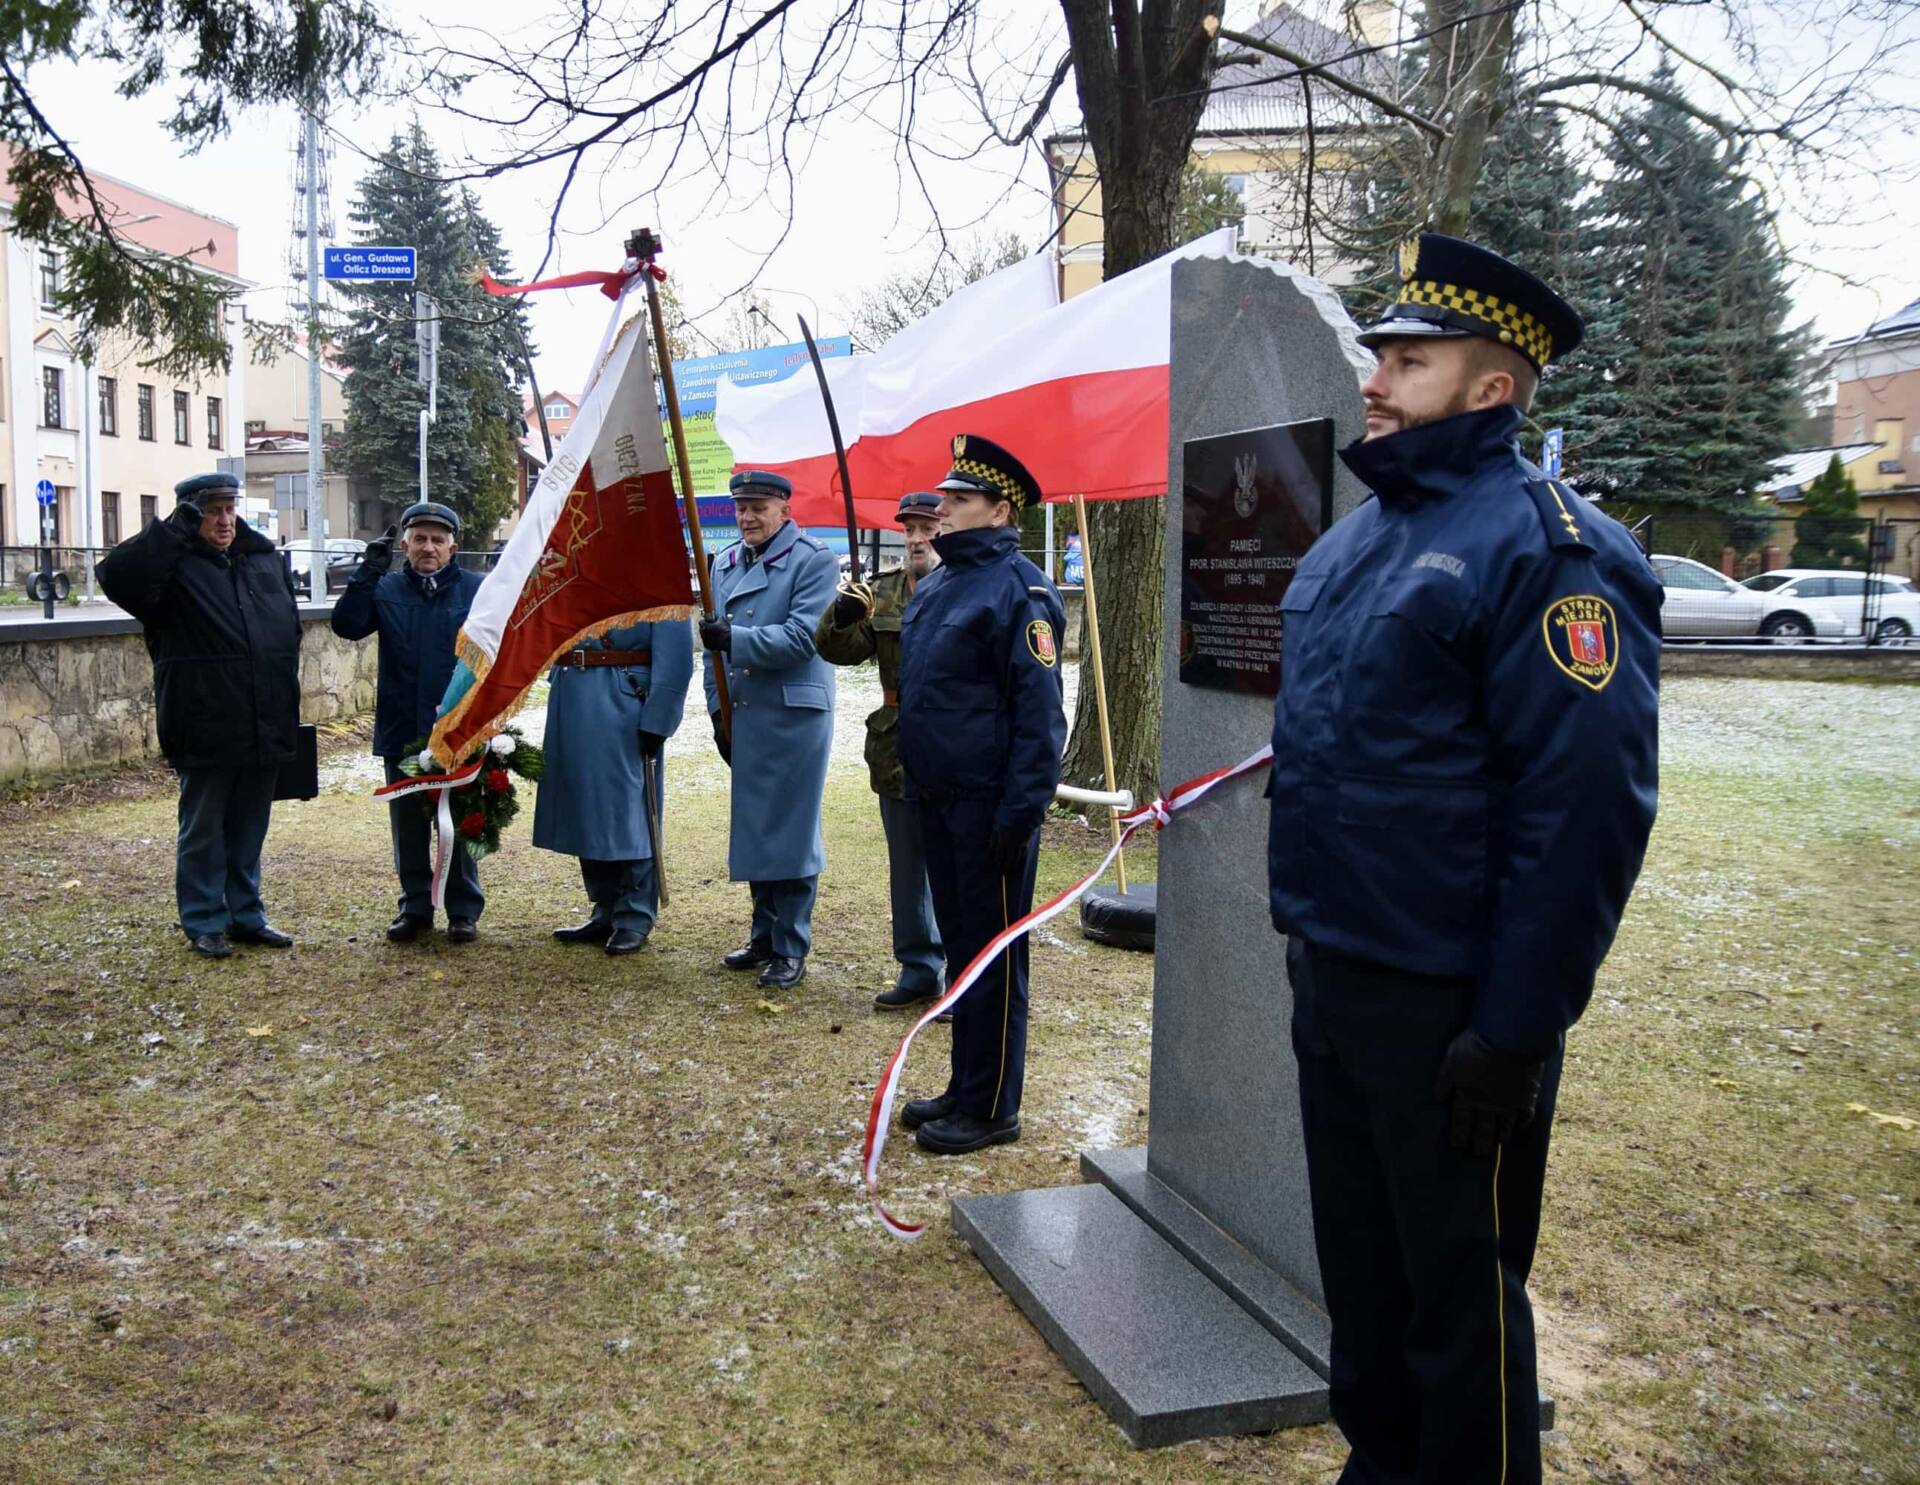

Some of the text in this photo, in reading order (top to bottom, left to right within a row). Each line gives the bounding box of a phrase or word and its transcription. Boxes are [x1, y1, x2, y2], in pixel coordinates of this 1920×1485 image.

[331, 253, 409, 263] ul. Gen. Gustawa
[343, 264, 411, 274] Orlicz Dreszera
[695, 408, 715, 422] Stacj
[1230, 538, 1261, 554] PAMIĘCI
[1254, 556, 1297, 569] WITESZCZA
[1555, 610, 1607, 627] MIEJSKA
